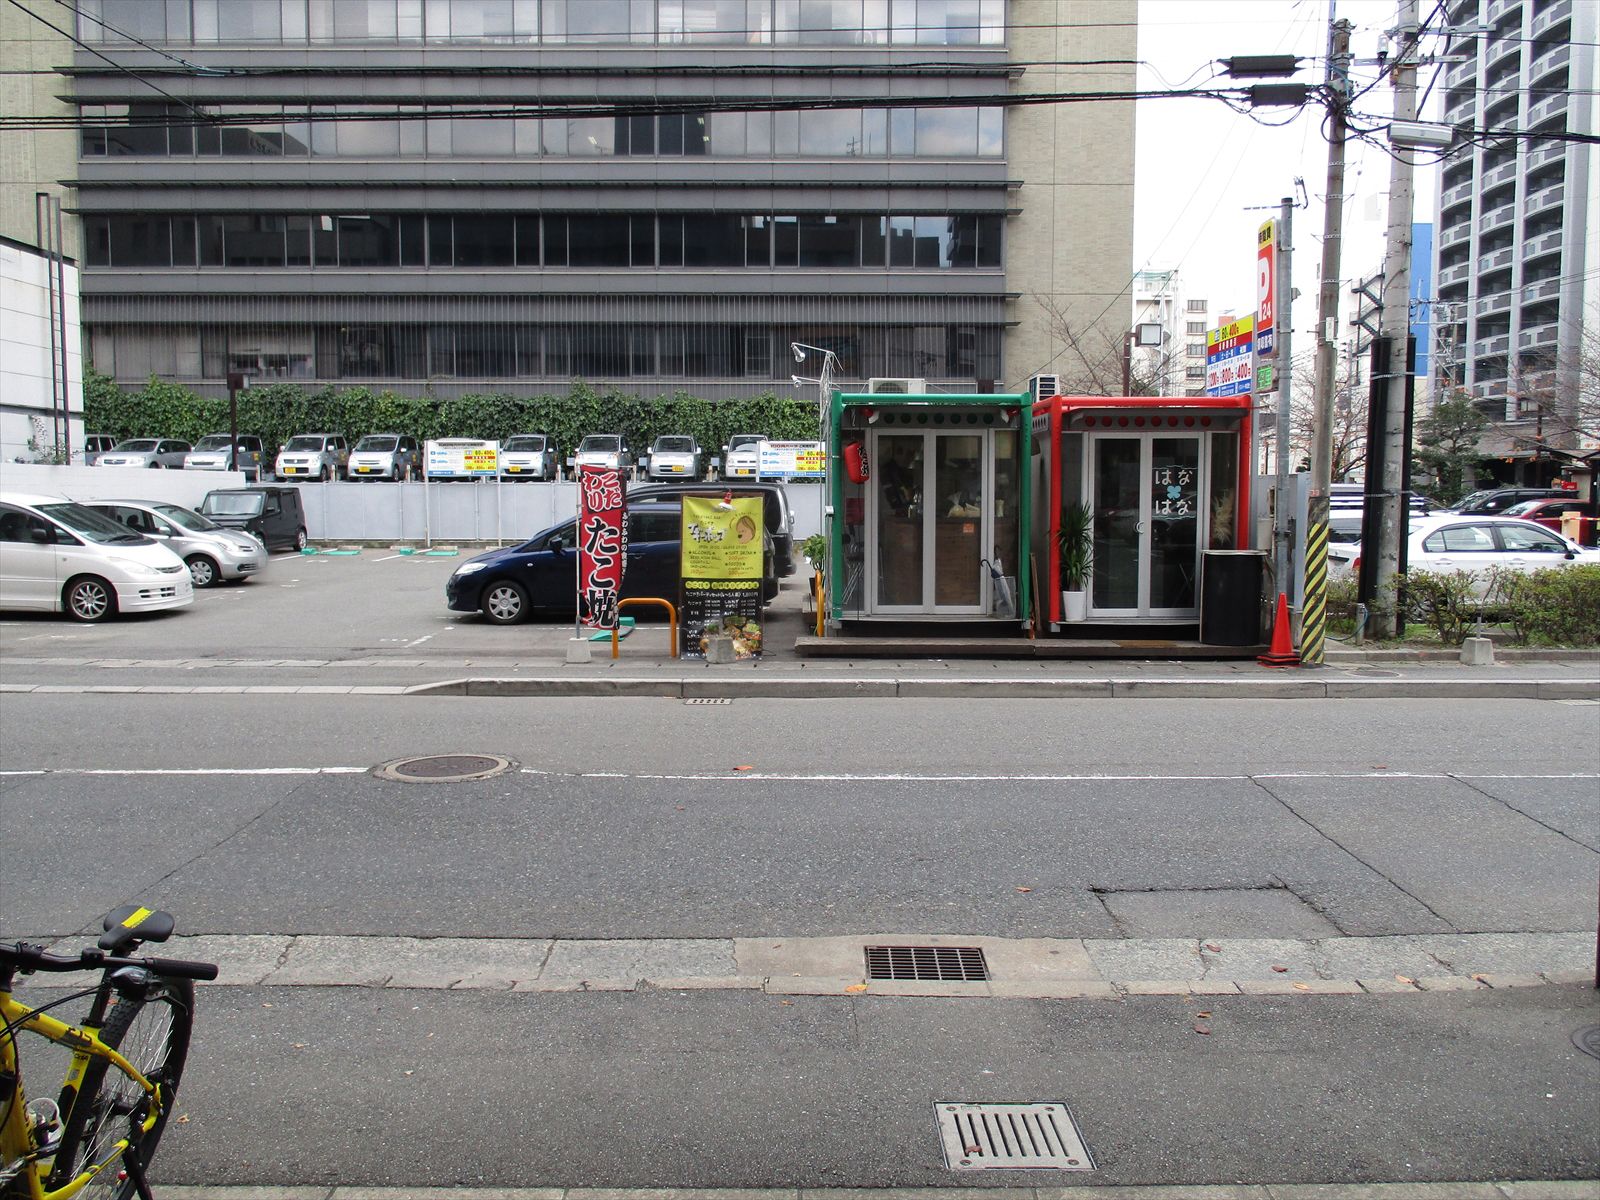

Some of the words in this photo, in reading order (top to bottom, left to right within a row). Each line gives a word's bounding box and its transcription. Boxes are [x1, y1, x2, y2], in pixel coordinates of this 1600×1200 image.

[1257, 256, 1270, 322] P
[1262, 301, 1271, 321] 24
[1155, 469, 1193, 486] はな
[1155, 498, 1192, 516] はな
